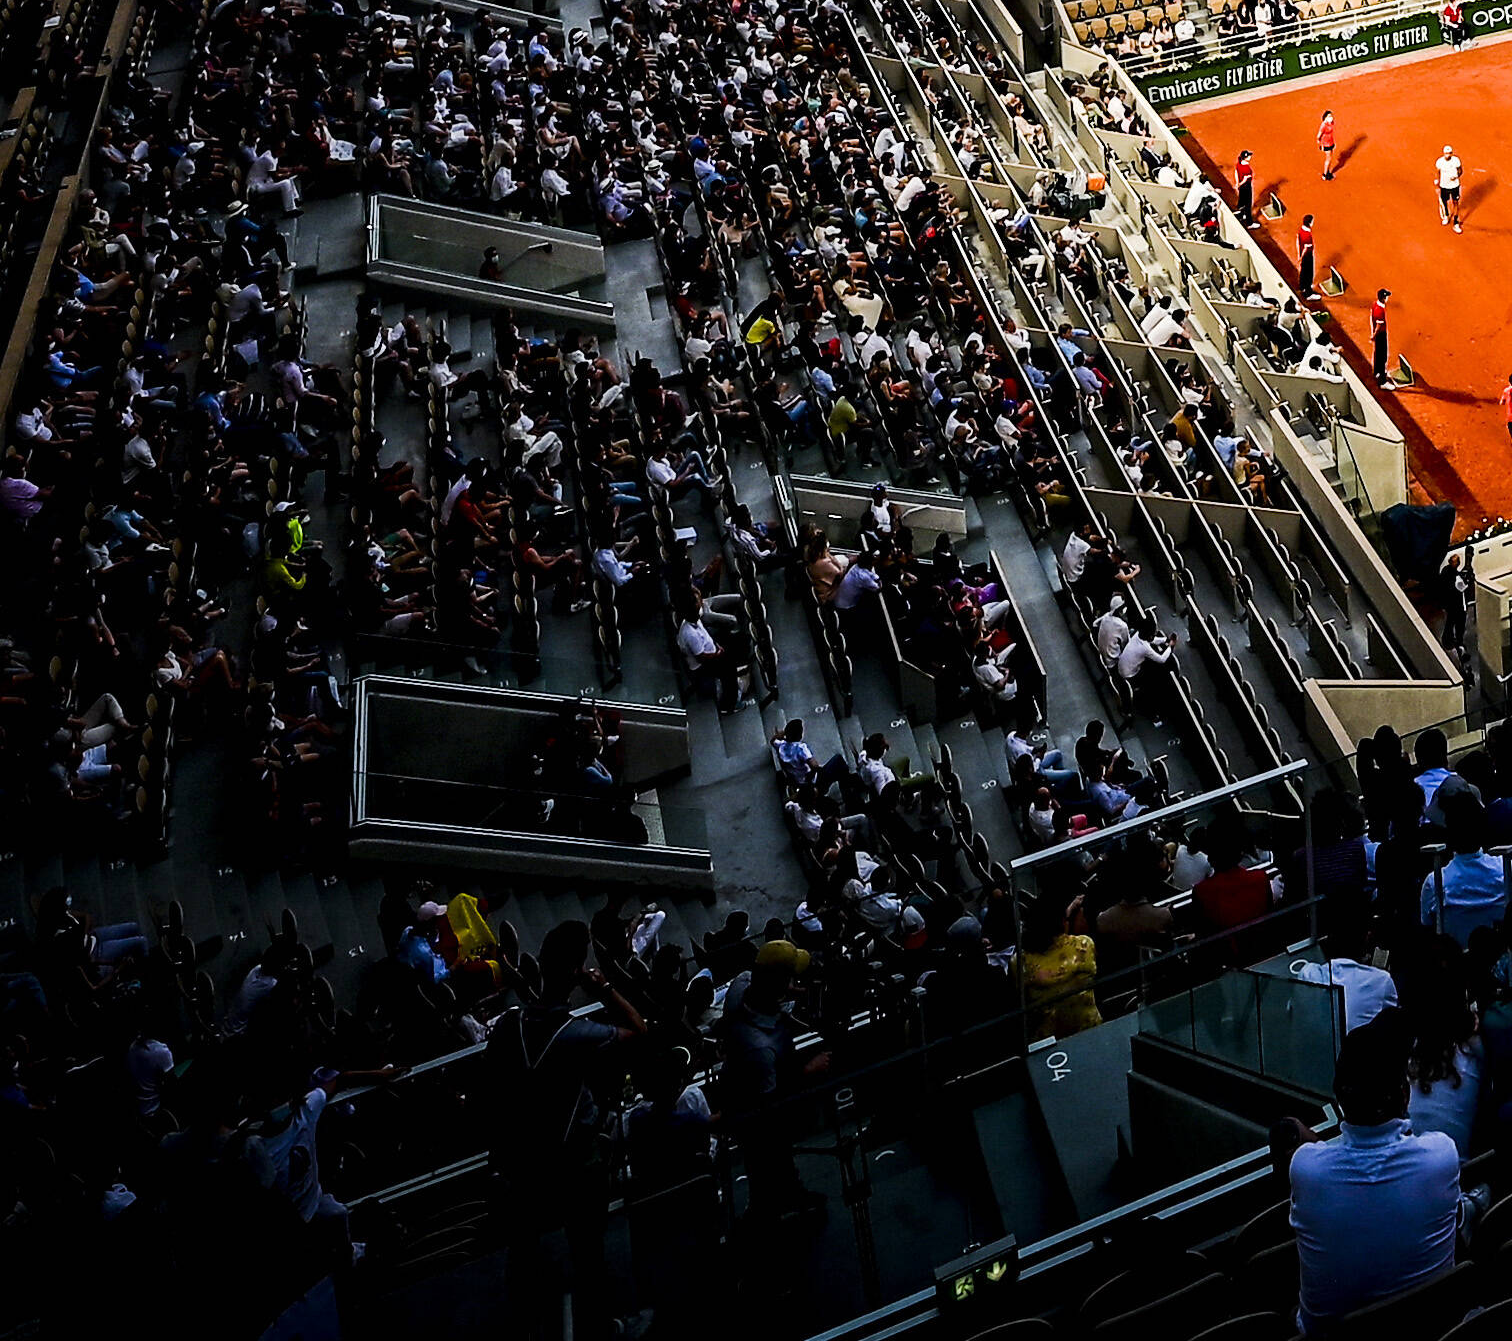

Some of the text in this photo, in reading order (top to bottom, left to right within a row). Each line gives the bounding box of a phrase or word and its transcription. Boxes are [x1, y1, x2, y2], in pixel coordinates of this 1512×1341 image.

[1298, 25, 1429, 71] Emirates FLY BETTER
[1148, 57, 1284, 104] Emirates FLY BETTER
[814, 703, 830, 714] 07
[1045, 1051, 1073, 1083] 04
